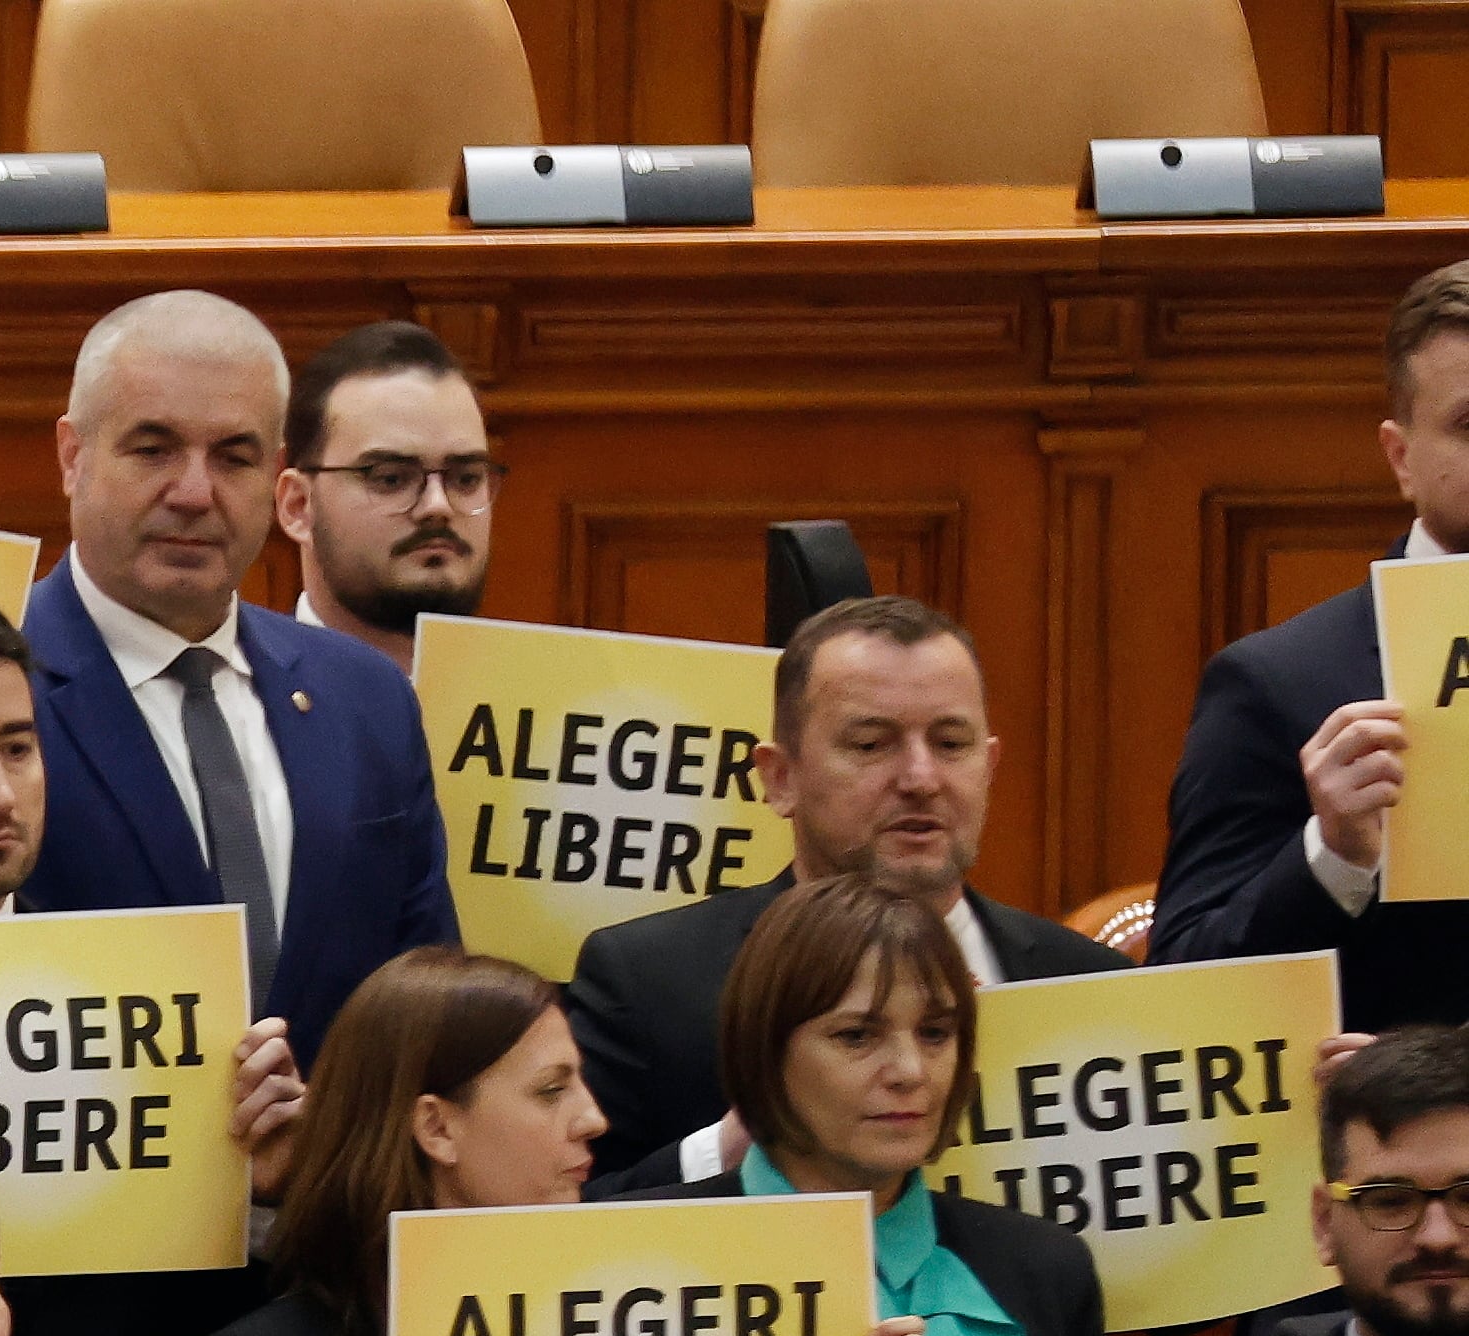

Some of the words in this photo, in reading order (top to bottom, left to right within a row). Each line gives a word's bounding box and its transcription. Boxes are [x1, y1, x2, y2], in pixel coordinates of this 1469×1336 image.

[448, 704, 767, 802] ALEGER
[470, 803, 754, 896] LIBERE
[947, 1038, 1292, 1147] LEGERI
[943, 1142, 1267, 1236] IBERE
